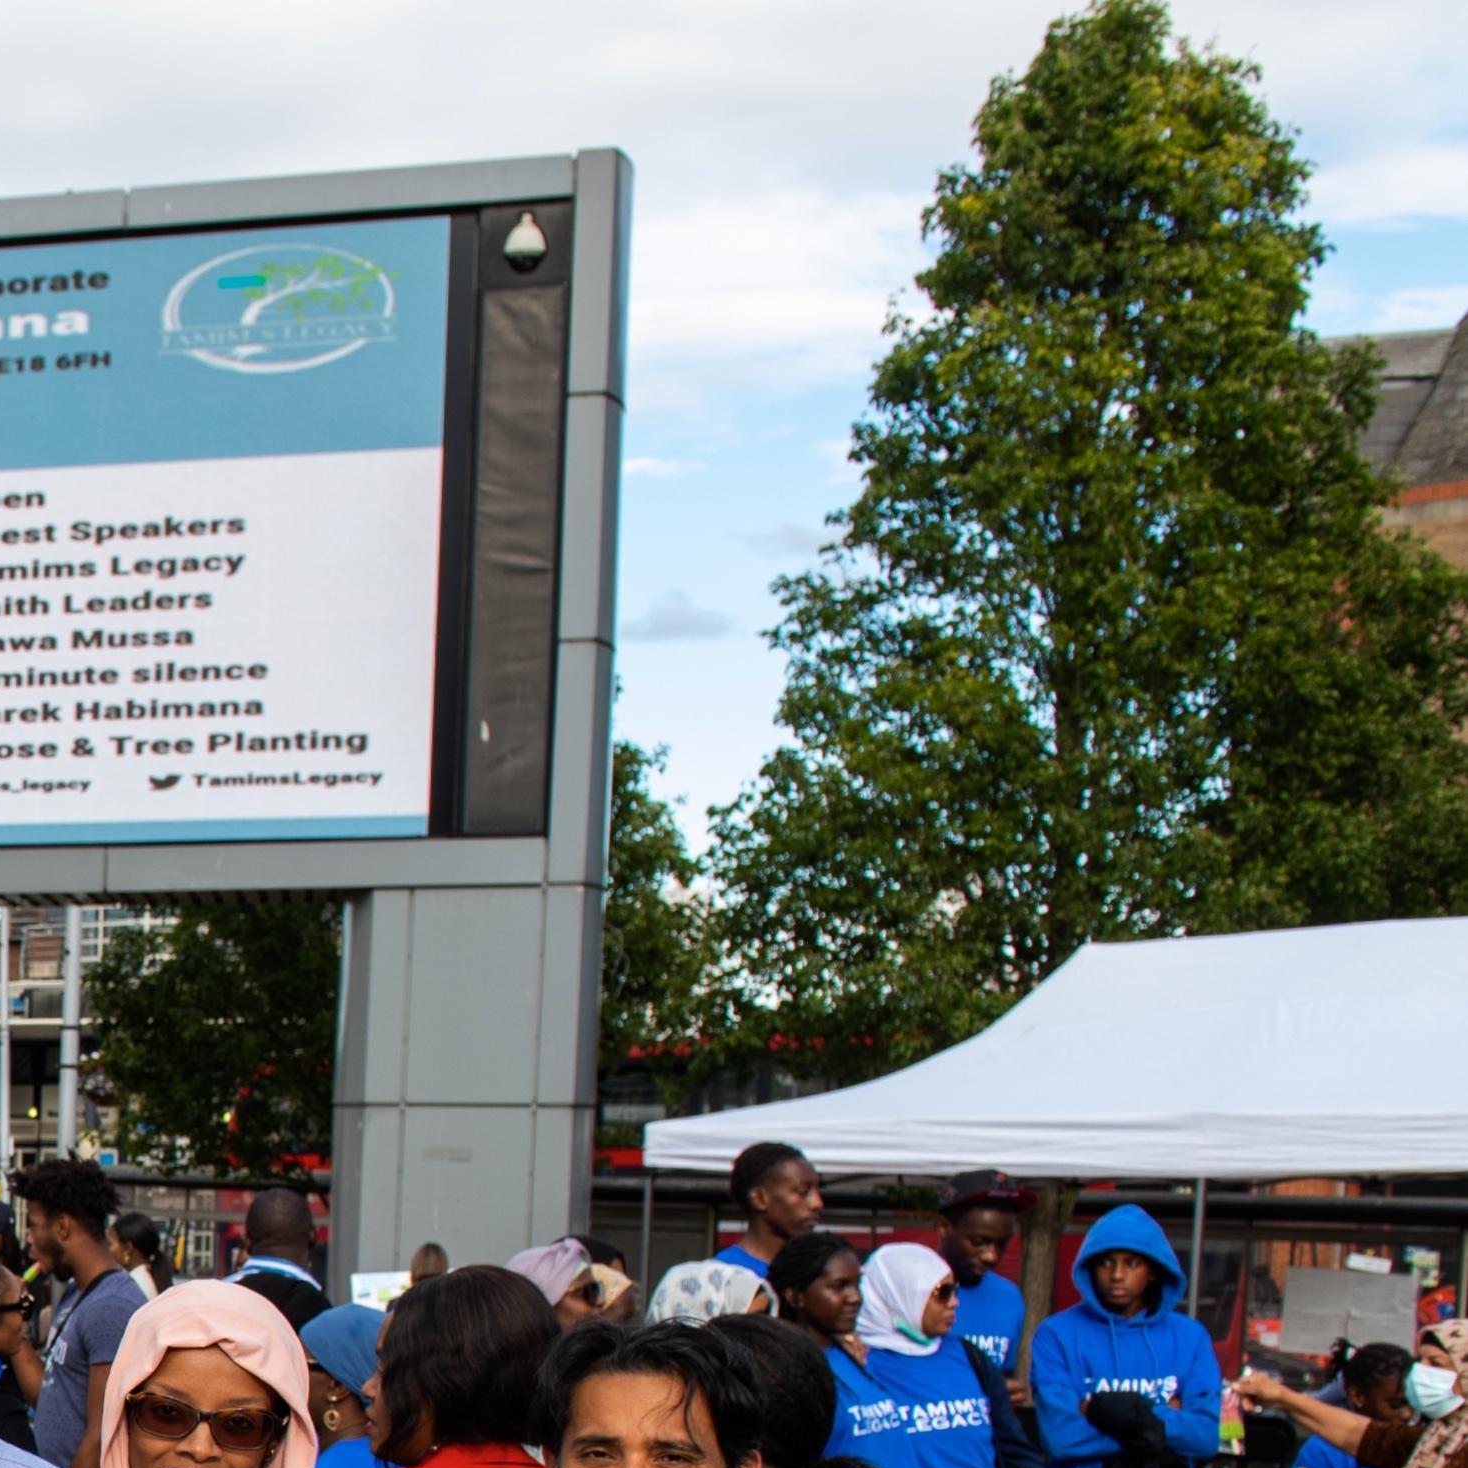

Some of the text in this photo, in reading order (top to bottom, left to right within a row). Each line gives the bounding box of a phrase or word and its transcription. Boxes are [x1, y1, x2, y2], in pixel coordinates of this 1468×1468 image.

[56, 351, 112, 370] 6FH
[70, 516, 246, 545] Speakers
[111, 553, 245, 579] Legacy
[63, 590, 213, 615] Leaders
[71, 627, 195, 650] Mussa
[132, 661, 269, 684] silence
[74, 698, 264, 722] Habimana
[71, 738, 95, 758] &
[108, 735, 195, 757] Tree
[207, 730, 369, 755] Planting
[192, 770, 384, 788] TamimsLegacy
